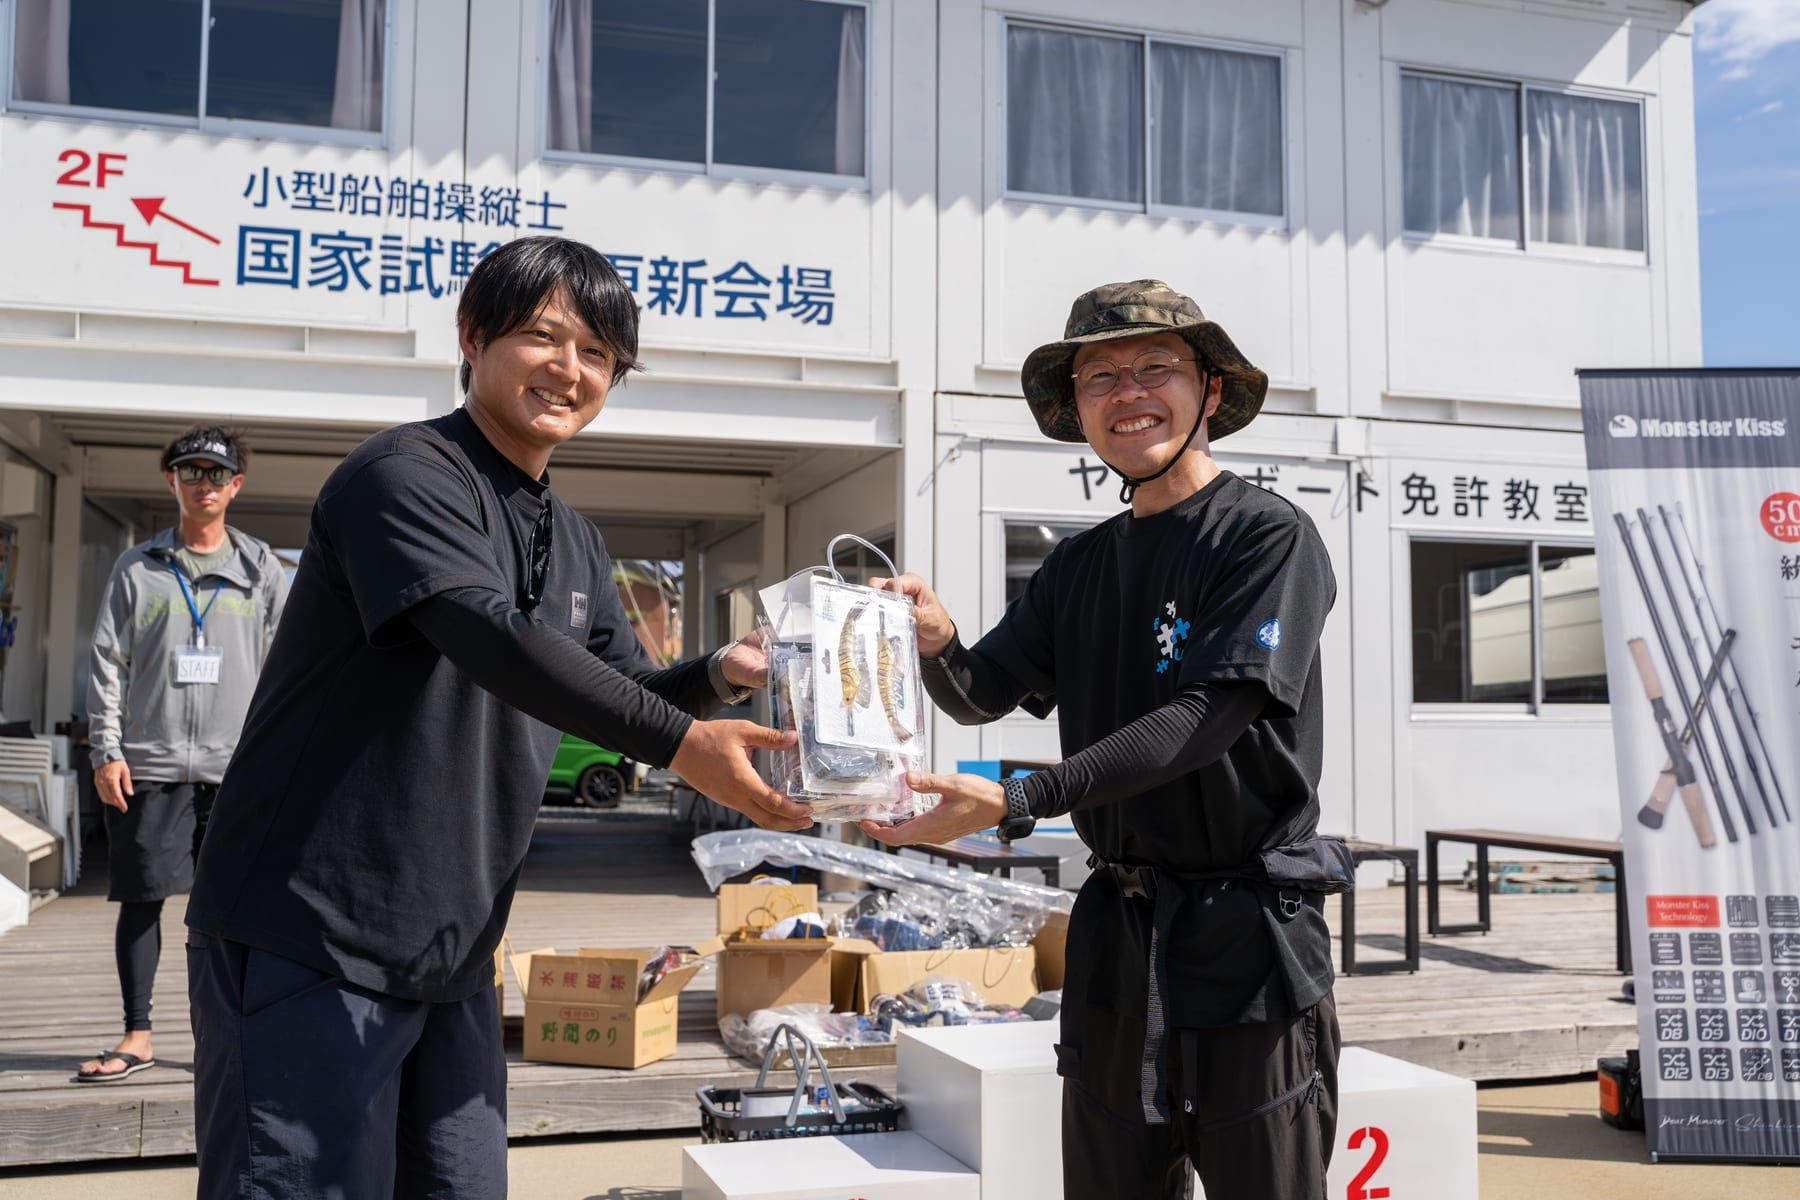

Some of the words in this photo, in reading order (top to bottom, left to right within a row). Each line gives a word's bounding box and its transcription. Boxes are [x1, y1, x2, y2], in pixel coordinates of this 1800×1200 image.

[57, 149, 128, 189] 2F
[243, 166, 567, 232] 小型船舶操縦士
[1640, 418, 1733, 438] Monster
[1735, 417, 1786, 437] Kiss
[179, 660, 219, 679] STAFF
[1656, 901, 1690, 910] Monster
[1692, 901, 1710, 910] Kiss
[1659, 911, 1708, 923] Technology
[541, 1022, 616, 1047] 野間のり
[1661, 1028, 1683, 1040] D8
[1701, 1029, 1723, 1040] D9
[1664, 1067, 1689, 1079] D12
[1705, 1068, 1730, 1080] D13
[1347, 1126, 1390, 1200] 2
